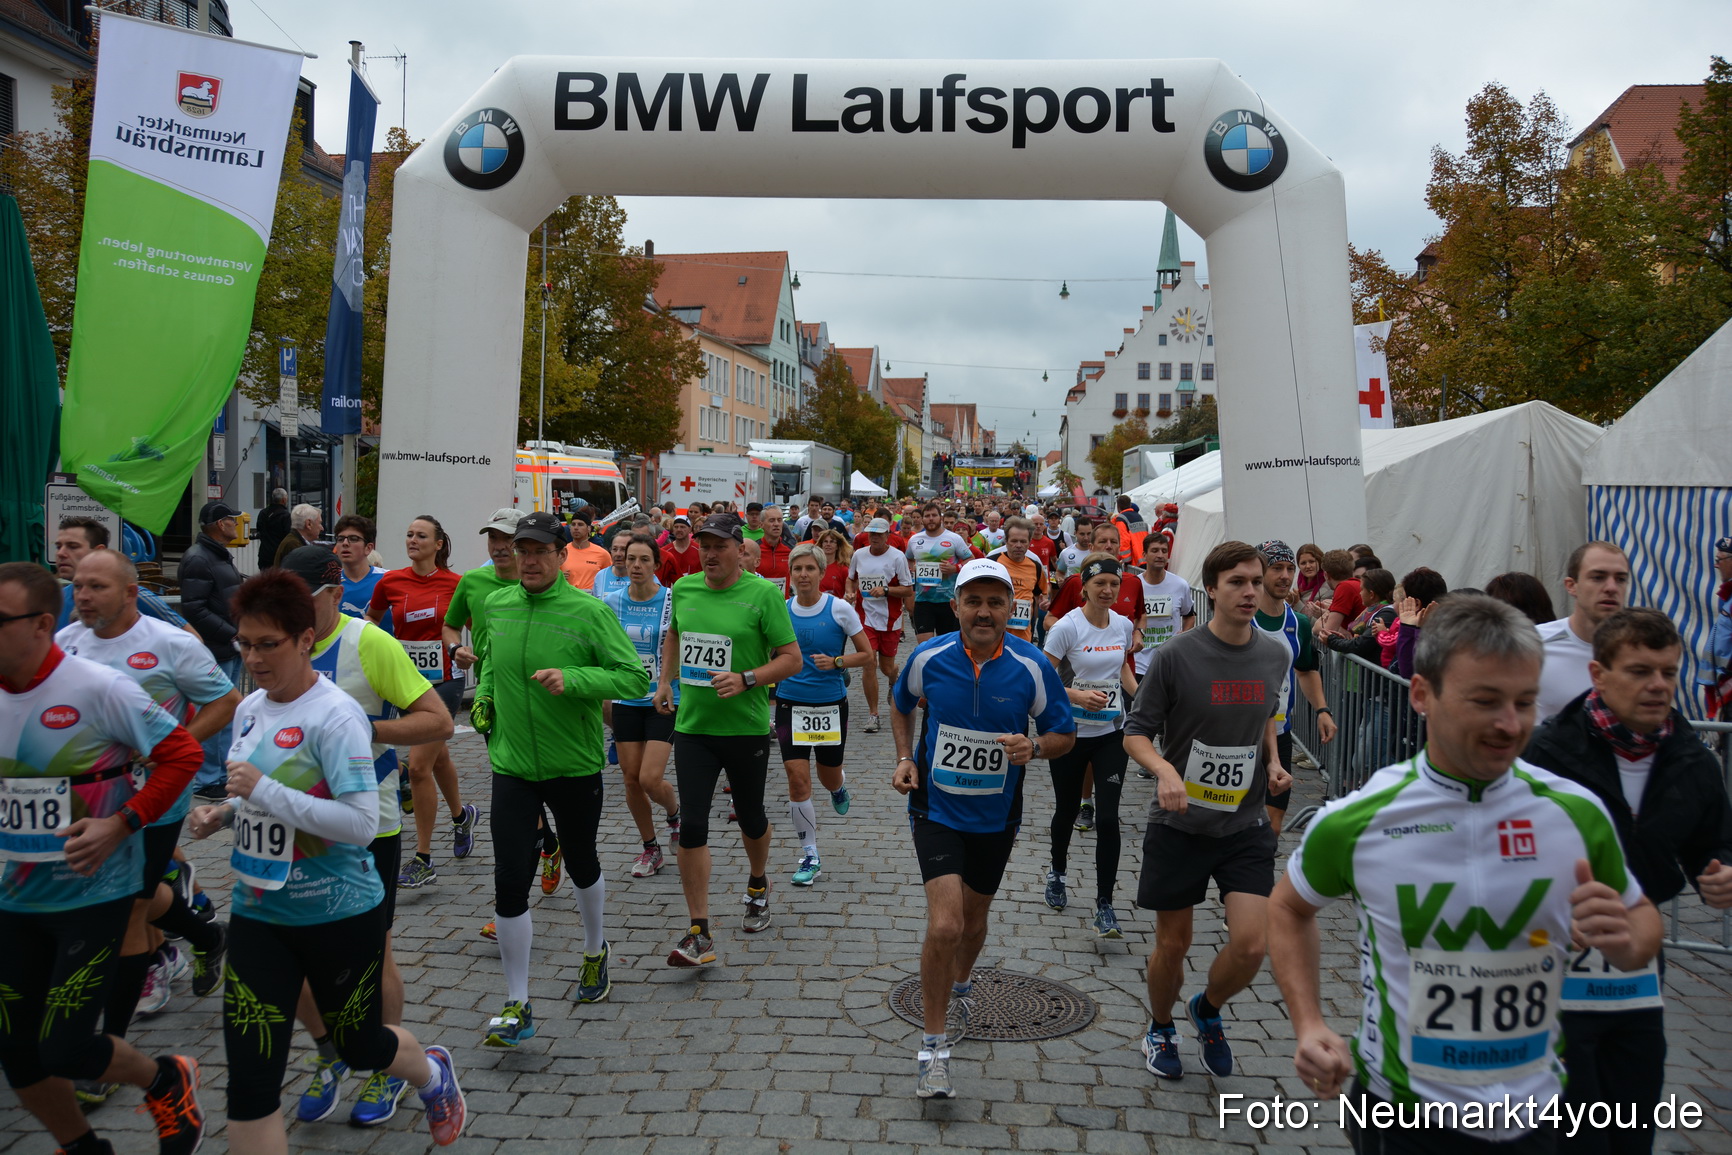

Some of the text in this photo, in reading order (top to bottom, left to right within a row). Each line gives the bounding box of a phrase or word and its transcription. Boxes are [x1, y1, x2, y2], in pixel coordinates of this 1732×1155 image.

[553, 71, 1177, 149] BMW Laufsport
[455, 110, 518, 136] BMW
[1212, 111, 1279, 138] BMW
[331, 395, 362, 408] railon
[382, 450, 491, 465] www.bmw-laufsport.de
[1245, 455, 1360, 471] www.bmw-laufsport.de
[50, 493, 88, 503] Fußgänger
[919, 567, 940, 578] 2541
[627, 605, 658, 613] VIERTL
[662, 602, 671, 626] VIERTL
[1145, 602, 1166, 615] 347
[696, 637, 723, 645] Neumarkt
[684, 644, 726, 667] 2743
[1210, 683, 1265, 702] NIXON
[1082, 710, 1107, 720] Kerstin
[802, 716, 831, 732] 303
[940, 730, 999, 746] PARTL Neumarkt
[941, 742, 1004, 772] 2269
[1192, 746, 1247, 760] PARTL Neumarkt
[954, 775, 983, 787] Xaver
[1199, 761, 1244, 787] 285
[1203, 789, 1235, 803] Martin
[1383, 822, 1456, 839] smartblock
[289, 886, 332, 899] Stadtlauf
[1414, 960, 1538, 979] PARTL Neumarkt
[1586, 982, 1638, 997] Andreas
[1426, 979, 1548, 1033] 2188
[1441, 1042, 1529, 1066] Reinhard
